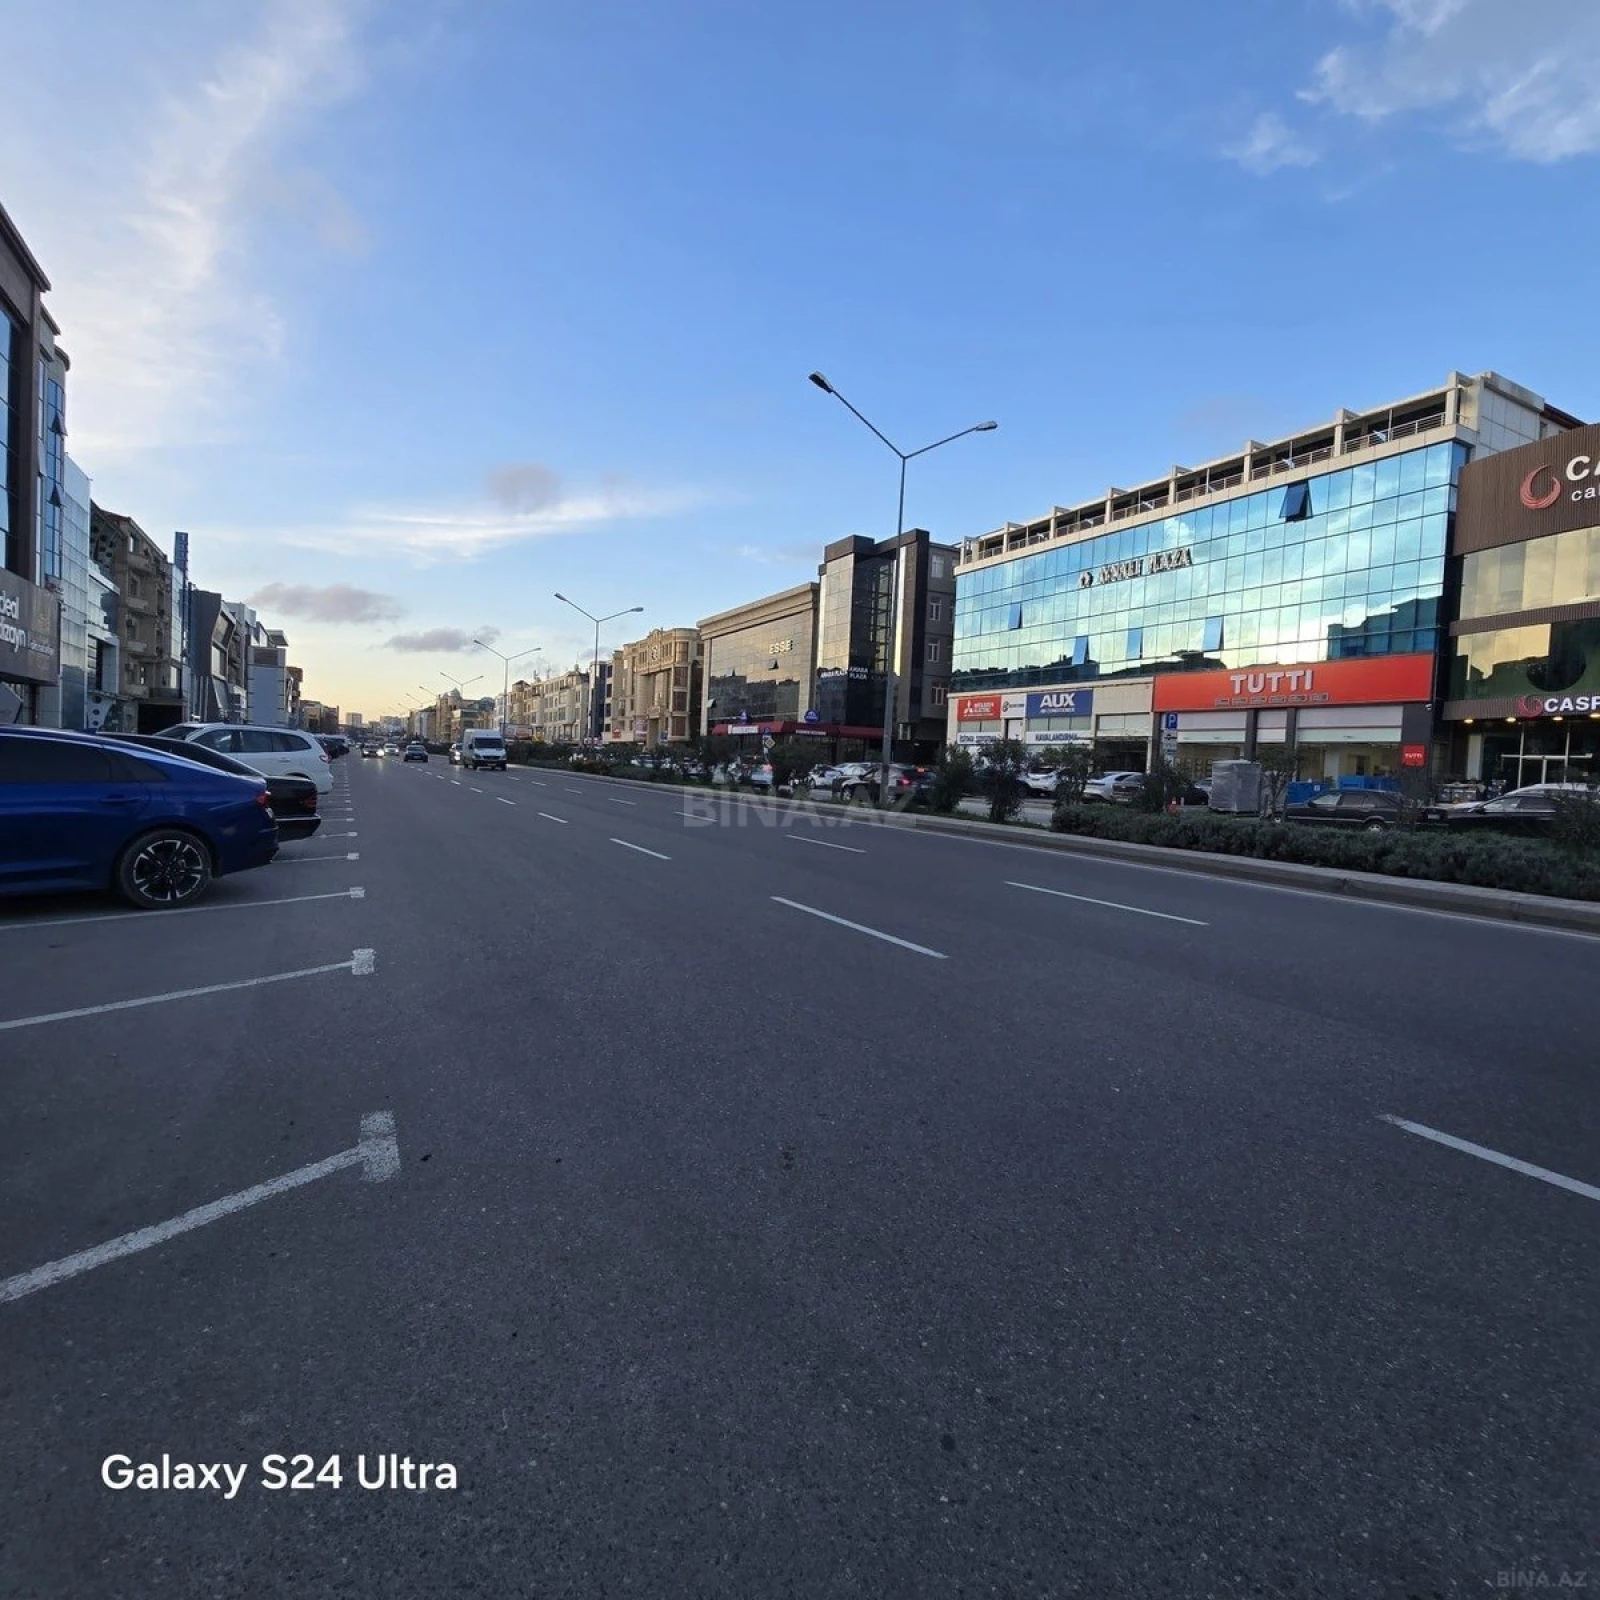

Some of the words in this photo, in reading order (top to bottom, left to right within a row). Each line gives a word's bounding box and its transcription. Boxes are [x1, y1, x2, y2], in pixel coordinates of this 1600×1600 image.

[1571, 484, 1600, 502] ca
[1148, 547, 1193, 574] PLAZA
[769, 640, 794, 654] ESSE
[1230, 669, 1314, 694] TUTTI
[1040, 692, 1076, 709] AUX
[1168, 714, 1177, 729] P
